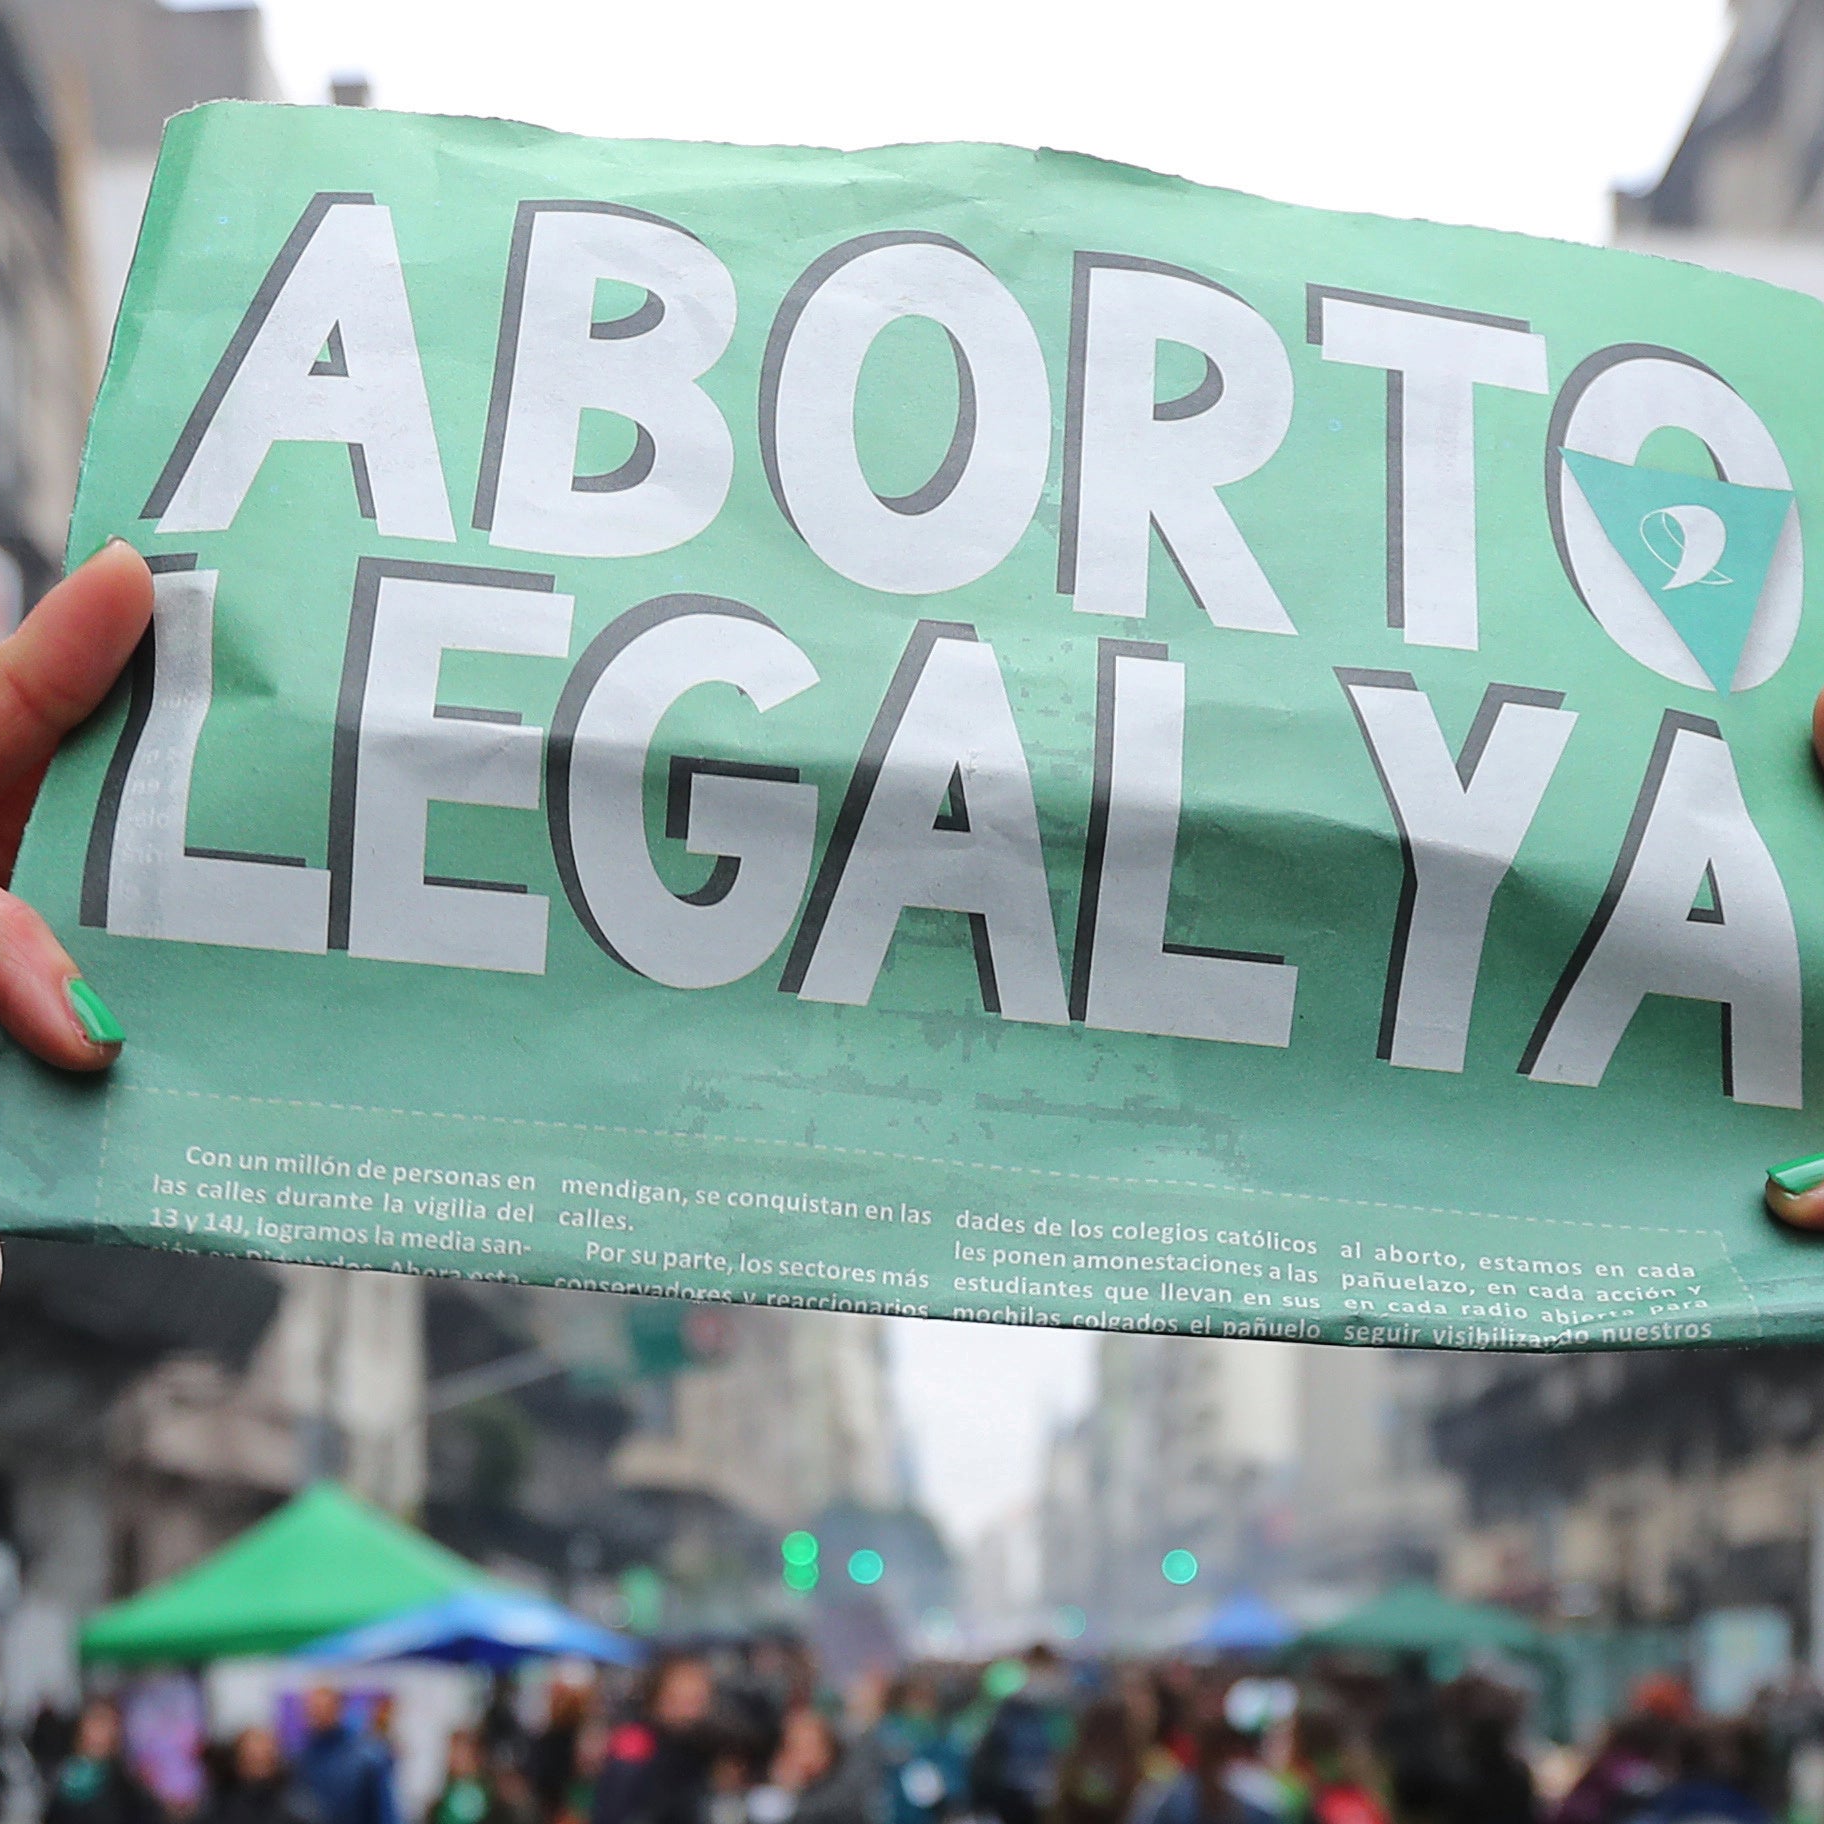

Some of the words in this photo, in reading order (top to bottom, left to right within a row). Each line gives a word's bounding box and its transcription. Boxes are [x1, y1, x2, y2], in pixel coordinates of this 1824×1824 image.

[140, 189, 1806, 695] ABORTO
[78, 553, 1299, 1050] LEGAL
[1336, 665, 1806, 1110] YA
[186, 1145, 233, 1167] Con
[239, 1152, 268, 1171] un
[275, 1153, 350, 1178] millón
[357, 1159, 386, 1181] de
[393, 1165, 501, 1189] personas
[508, 1174, 536, 1191] en
[152, 1174, 187, 1196] las
[197, 1179, 266, 1204] calles
[276, 1185, 374, 1212] durante
[383, 1193, 404, 1214] la
[414, 1194, 487, 1221] vigilia
[496, 1200, 534, 1224] del
[559, 1209, 635, 1232] calles.
[562, 1175, 688, 1205] mendigan,
[696, 1188, 720, 1205] se
[727, 1191, 858, 1219] conquistan
[865, 1204, 893, 1222] en
[901, 1203, 931, 1225] las
[149, 1208, 179, 1228] 13
[185, 1212, 199, 1235] y
[257, 1217, 368, 1245] logramos
[374, 1224, 395, 1246] la
[401, 1227, 475, 1252] media
[481, 1237, 531, 1257] san-
[956, 1210, 1025, 1235] dades
[1034, 1217, 1062, 1238] de
[1071, 1219, 1104, 1240] los
[1112, 1222, 1209, 1245] colegios
[1217, 1229, 1318, 1255] católicos
[585, 1240, 626, 1264] Por
[631, 1247, 657, 1267] su
[663, 1250, 734, 1276] parte,
[740, 1252, 773, 1275] los
[779, 1259, 876, 1284] sectores
[882, 1267, 929, 1289] más
[954, 1241, 987, 1261] les
[993, 1246, 1066, 1268] ponen
[1073, 1252, 1262, 1280] amonestaciones
[1269, 1265, 1281, 1281] a
[1287, 1263, 1319, 1285] las
[1340, 1241, 1360, 1260] al
[1375, 1246, 1467, 1271] aborto,
[1479, 1255, 1582, 1276] estamos
[1595, 1262, 1624, 1278] en
[1637, 1262, 1696, 1280] cada
[954, 1275, 1093, 1299] estudiantes
[1104, 1283, 1149, 1303] que
[1161, 1282, 1232, 1304] llevan
[1243, 1291, 1271, 1306] en
[1282, 1293, 1320, 1310] sus
[1341, 1269, 1476, 1296] pañuelazo,
[1487, 1281, 1517, 1297] en
[1528, 1283, 1584, 1302] cada
[1596, 1283, 1676, 1302] acción
[1344, 1296, 1375, 1312] en
[1387, 1299, 1448, 1316] cada
[1461, 1301, 1528, 1319] radio
[1649, 1299, 1709, 1315] para
[952, 1305, 1061, 1326] mochilas
[1072, 1311, 1178, 1333] colgados
[1190, 1315, 1211, 1335] el
[1222, 1317, 1321, 1339] pañuelo
[1344, 1323, 1421, 1345] seguir
[1602, 1321, 1713, 1343] nuestros
